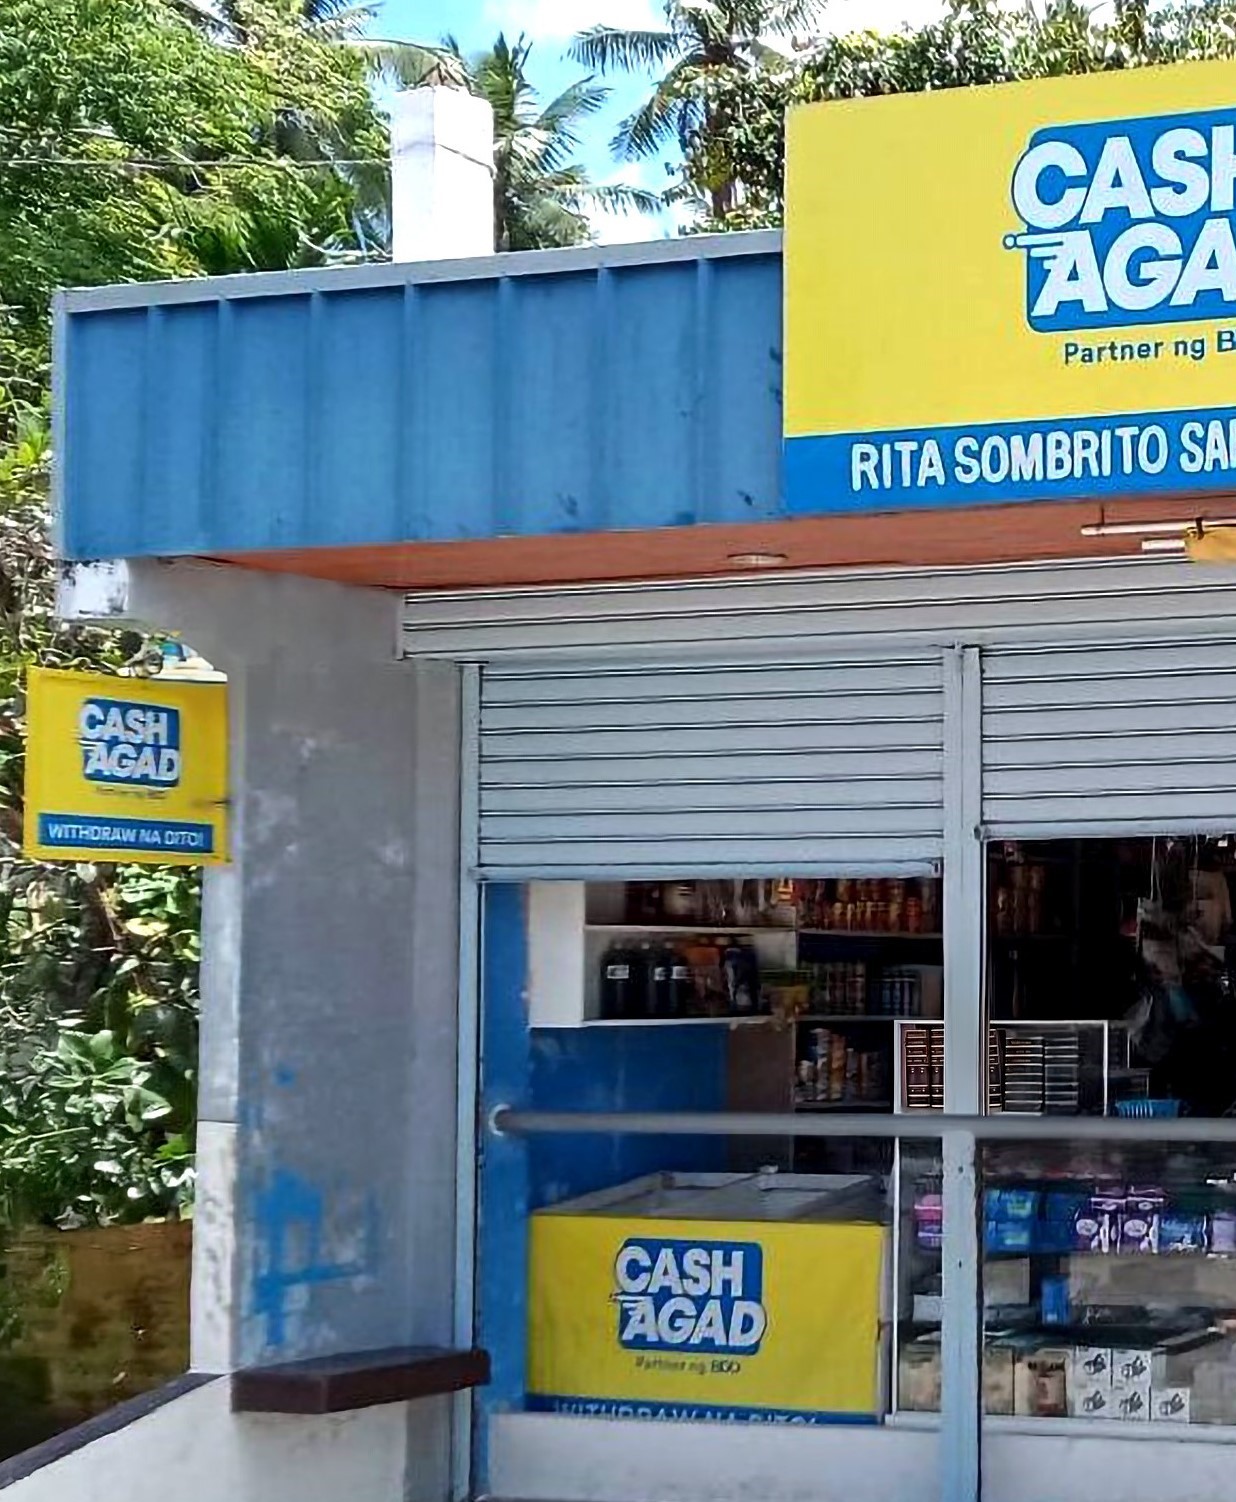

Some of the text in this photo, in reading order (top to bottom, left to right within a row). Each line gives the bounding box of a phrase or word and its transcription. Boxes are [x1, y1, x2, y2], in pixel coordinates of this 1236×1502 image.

[1064, 341, 1165, 364] Partner
[1174, 338, 1206, 361] ng
[851, 439, 946, 492] RITA
[954, 424, 1169, 484] SOMBRITO
[80, 703, 168, 746] CASH
[84, 742, 181, 782] AGAD
[48, 823, 204, 847] WITHDRAW NA DITO!
[615, 1245, 744, 1298] CASH
[621, 1298, 767, 1347] AGAD
